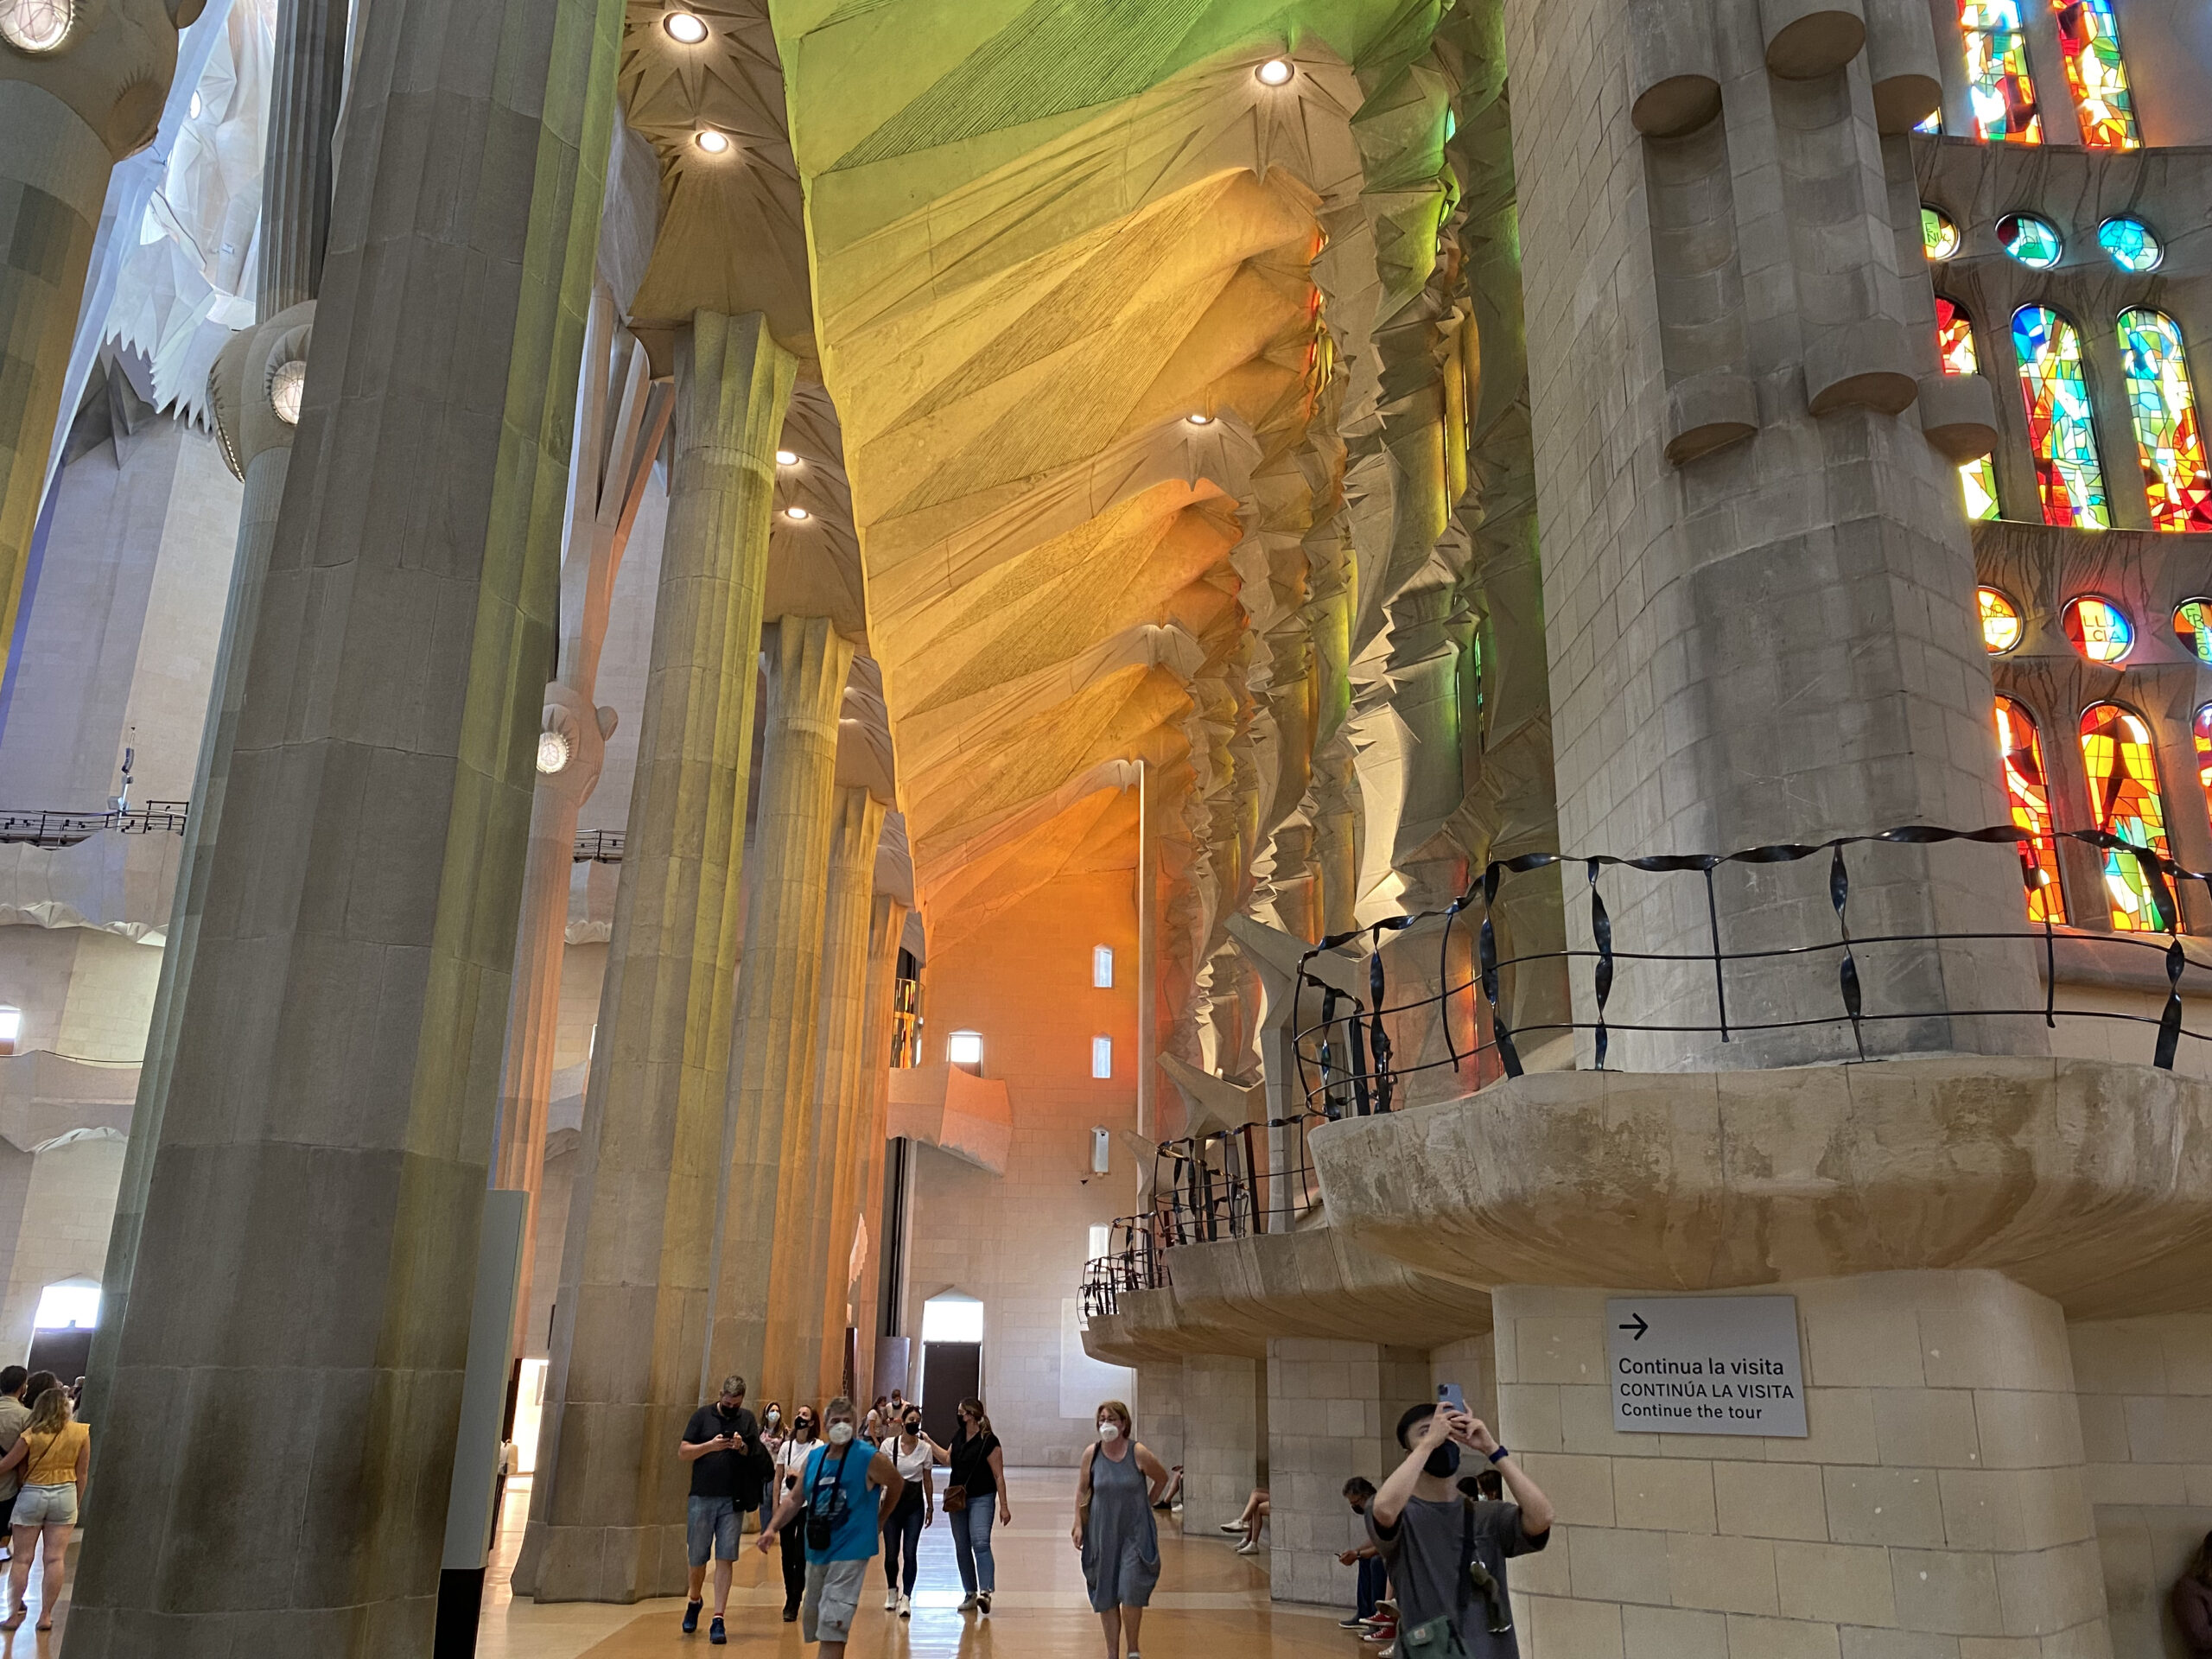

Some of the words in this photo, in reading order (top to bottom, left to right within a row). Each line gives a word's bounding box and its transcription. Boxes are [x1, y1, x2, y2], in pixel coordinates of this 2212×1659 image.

[1618, 1357, 1703, 1376] Continua
[1708, 1357, 1726, 1376] la
[1730, 1357, 1784, 1376] visita
[1620, 1381, 1708, 1398] CONTINÚA
[1712, 1383, 1733, 1398] LA
[1737, 1383, 1795, 1399] VISITA
[1621, 1402, 1693, 1418] Continue
[1696, 1404, 1723, 1419] the
[1727, 1406, 1763, 1420] tour
